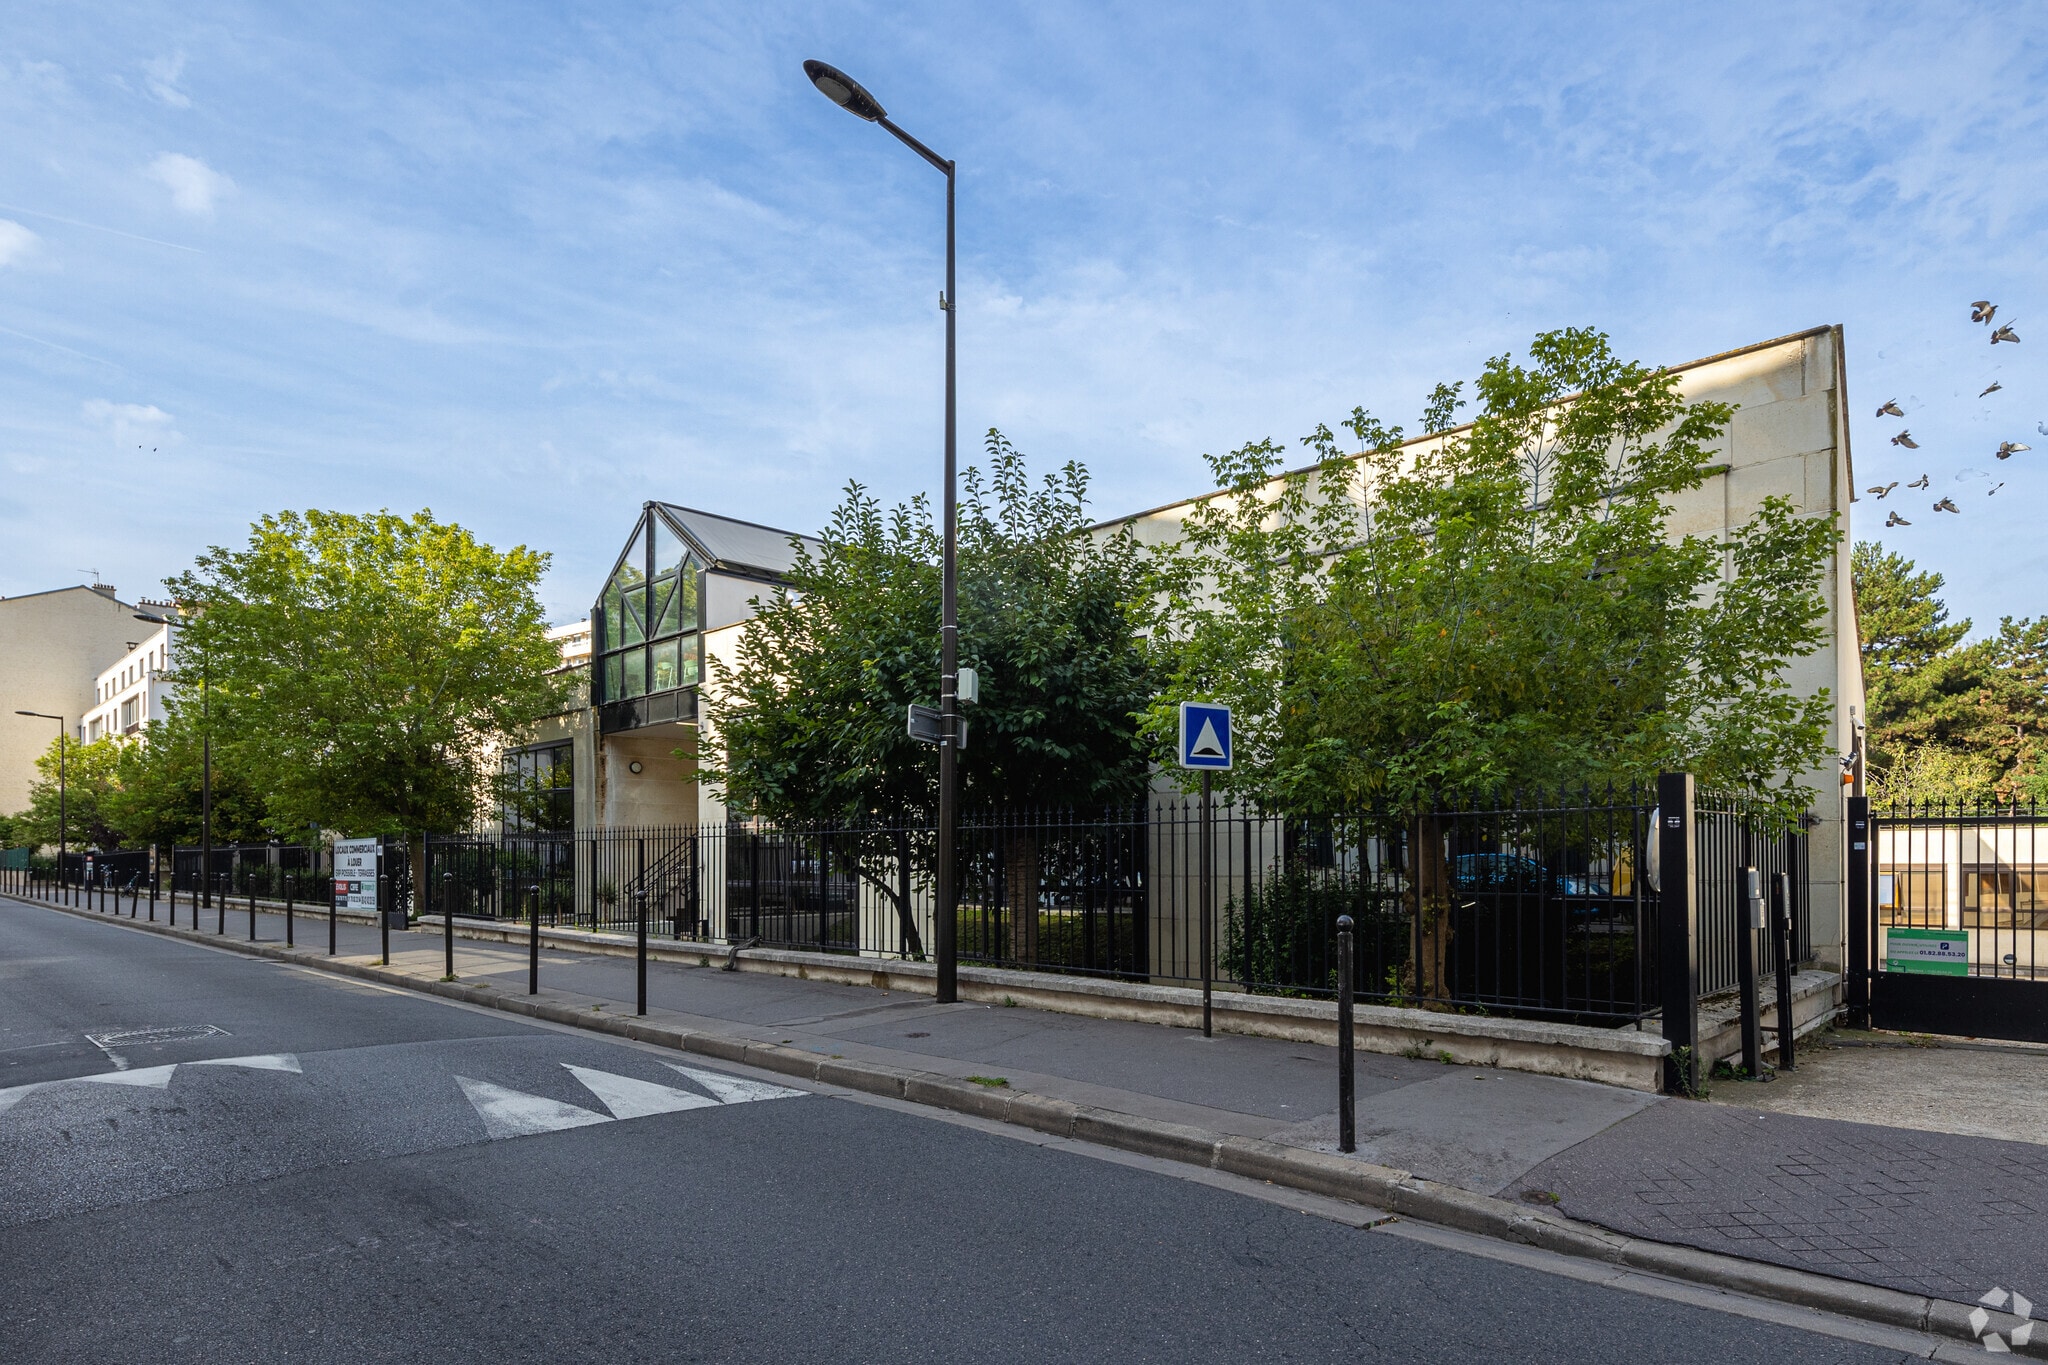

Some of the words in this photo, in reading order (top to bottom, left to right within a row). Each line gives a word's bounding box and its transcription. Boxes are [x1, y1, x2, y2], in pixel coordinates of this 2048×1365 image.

[336, 846, 348, 854] LOCAUX
[349, 844, 375, 854] COMMERCIAUX
[351, 857, 362, 866] LOUER
